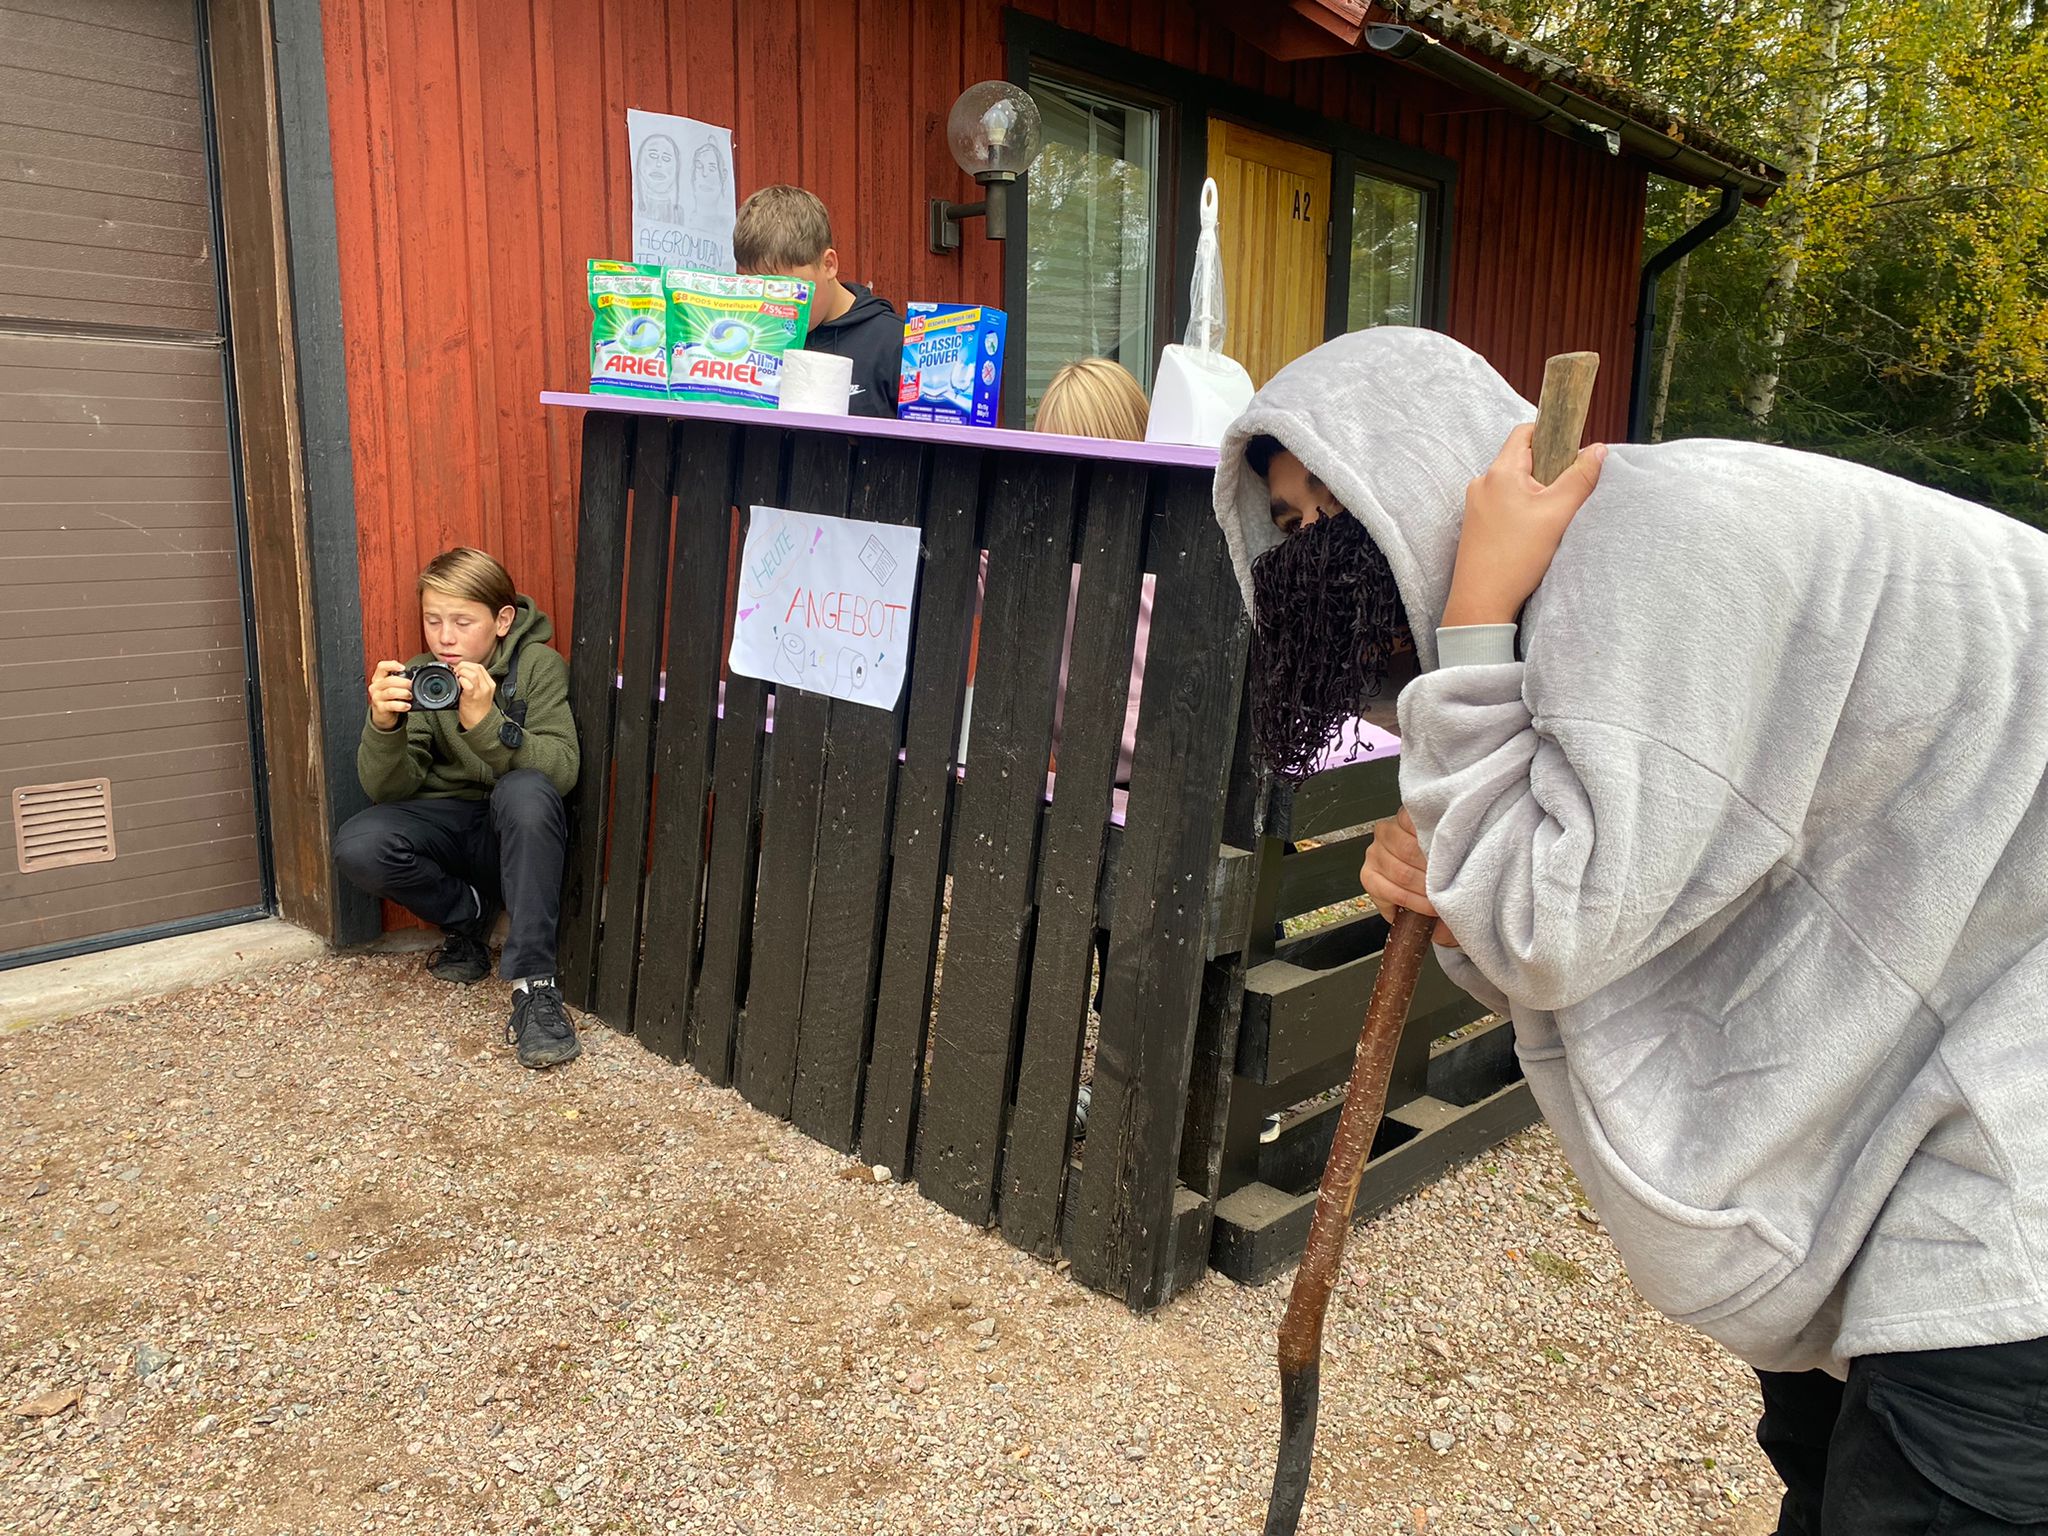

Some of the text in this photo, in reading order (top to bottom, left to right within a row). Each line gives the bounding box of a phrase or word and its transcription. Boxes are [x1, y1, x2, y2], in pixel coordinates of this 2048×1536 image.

[1292, 189, 1311, 222] A2
[689, 296, 711, 306] PODS
[763, 303, 783, 315] 75%
[918, 334, 962, 355] CLASSIC
[604, 354, 667, 378] ARIEL
[919, 349, 959, 369] POWER
[689, 359, 763, 387] ARIEL
[757, 367, 777, 377] PODS
[751, 526, 795, 588] HEUTE
[784, 586, 907, 641] ANGEBOT
